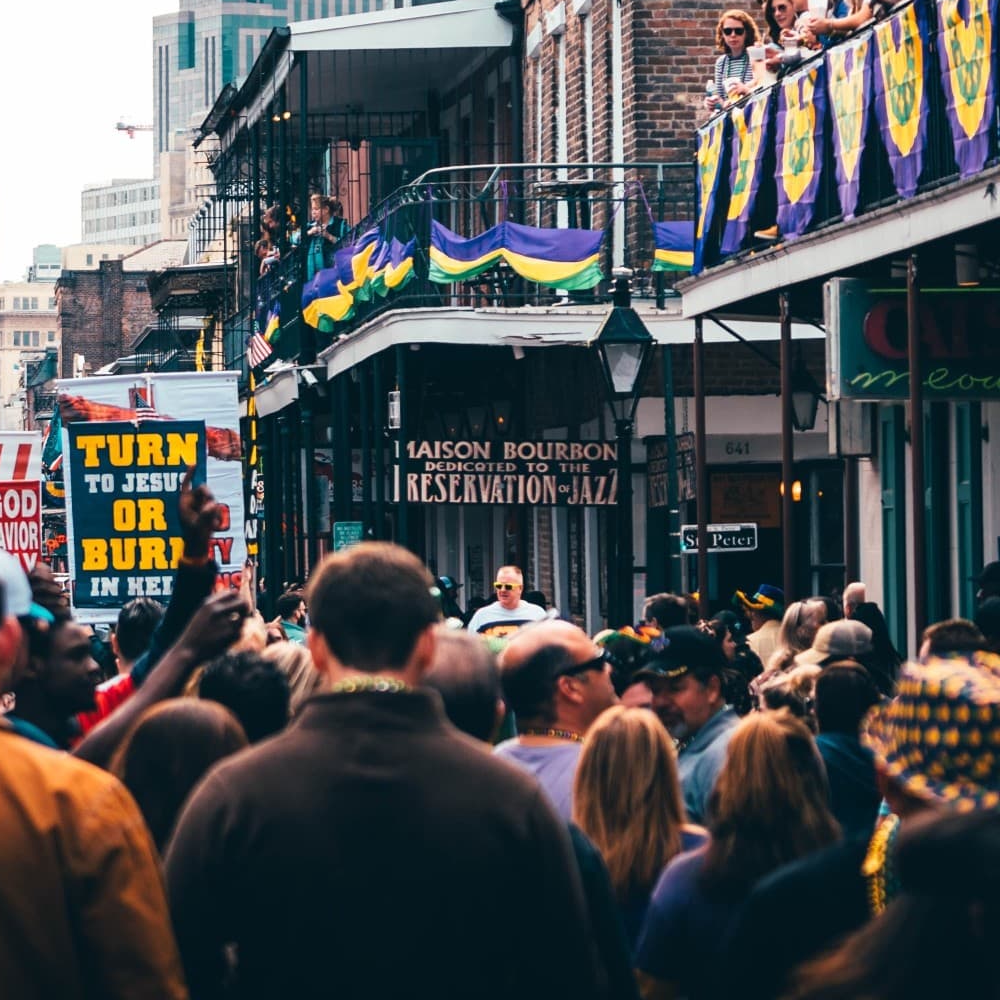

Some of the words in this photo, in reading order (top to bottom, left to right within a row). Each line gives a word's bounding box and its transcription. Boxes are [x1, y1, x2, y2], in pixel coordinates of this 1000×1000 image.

[76, 433, 198, 467] TURN
[504, 441, 617, 461] BOURBON
[725, 441, 750, 455] 641
[425, 461, 517, 472] DEDICATED
[526, 462, 549, 472] TO
[559, 462, 591, 473] THE
[84, 473, 114, 493] TO
[568, 468, 617, 504] JAZZ
[113, 499, 167, 531] OR
[713, 533, 753, 547] Peter
[90, 577, 119, 597] IN
[127, 576, 174, 596] HEL
